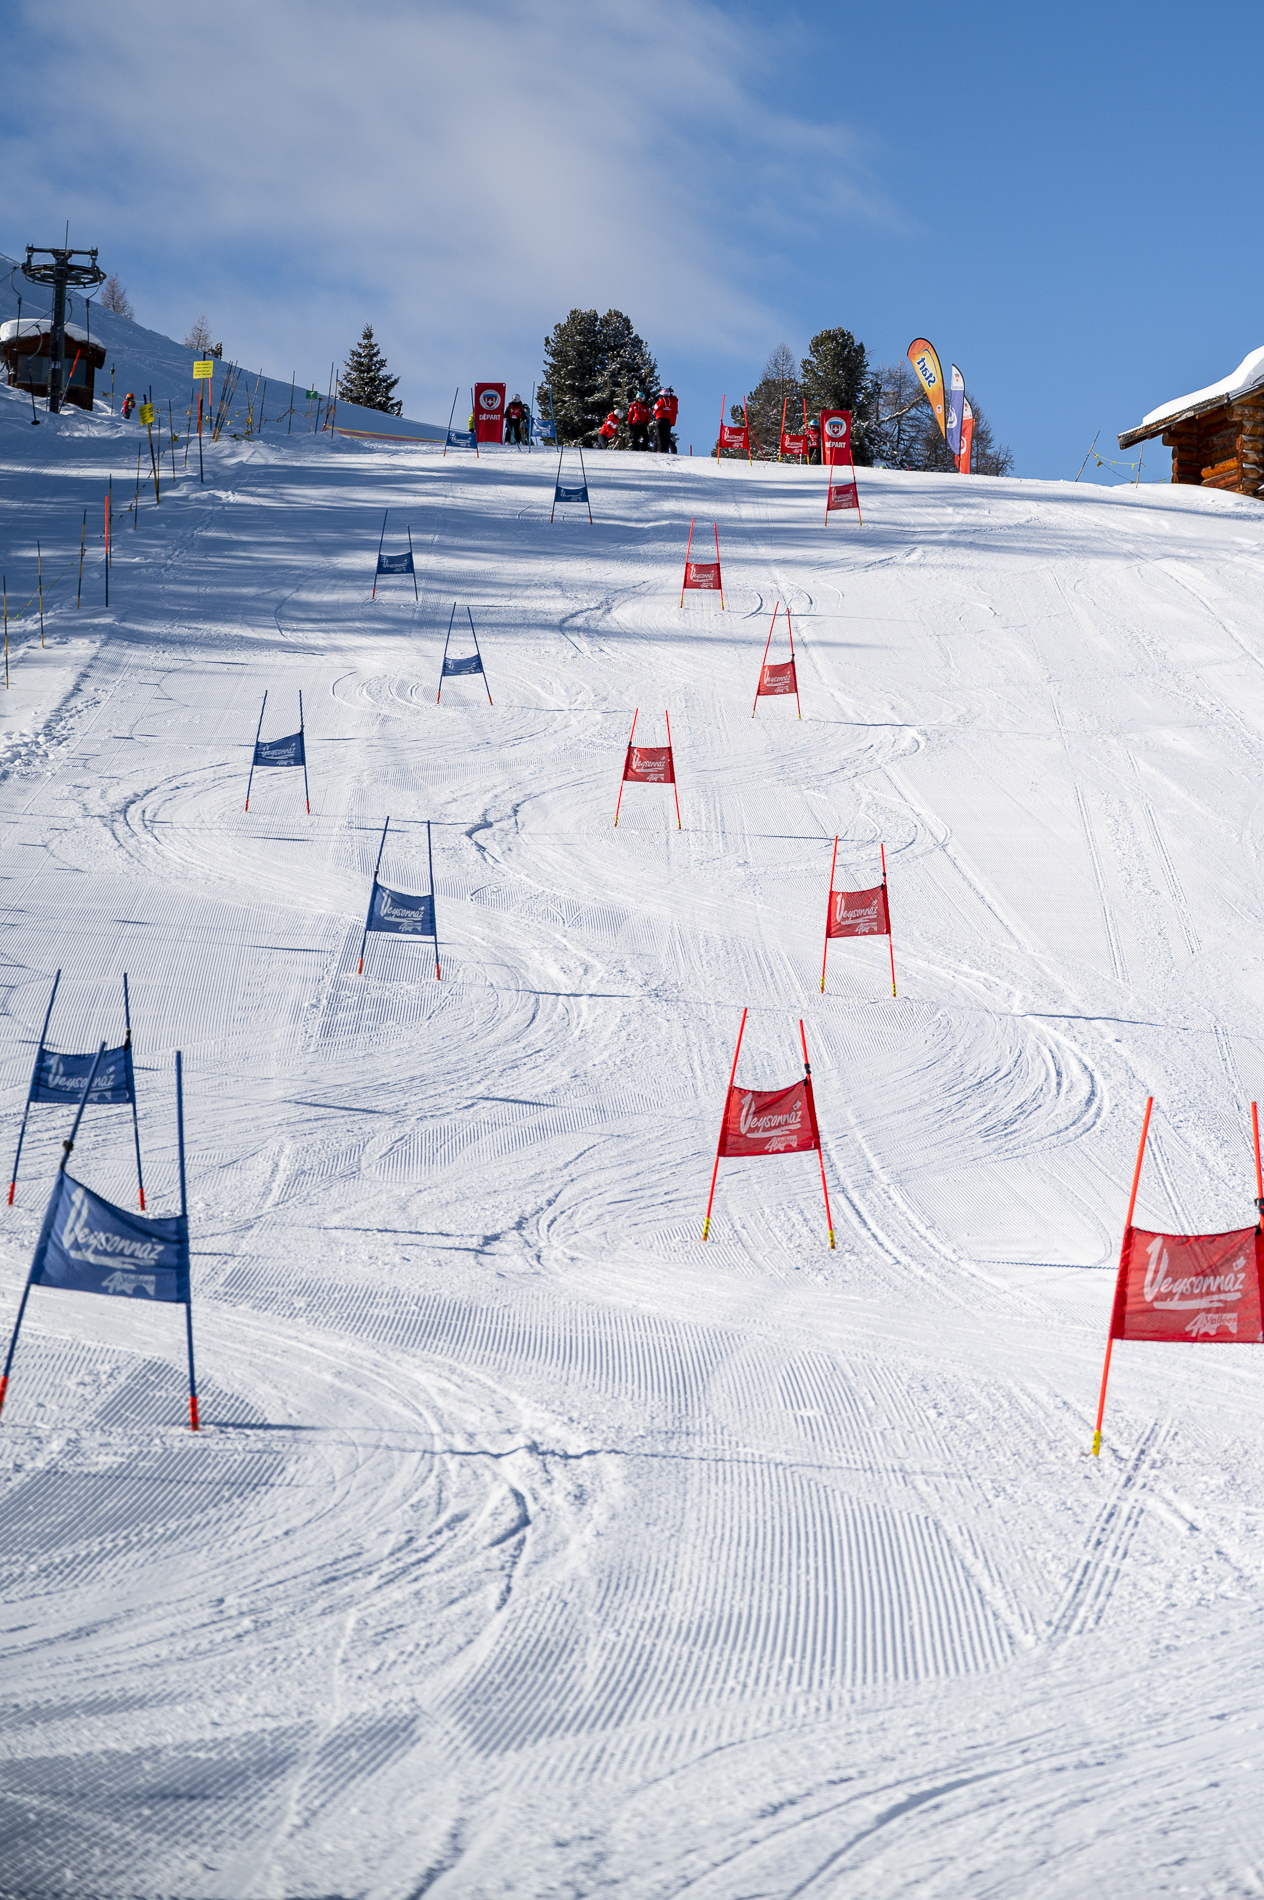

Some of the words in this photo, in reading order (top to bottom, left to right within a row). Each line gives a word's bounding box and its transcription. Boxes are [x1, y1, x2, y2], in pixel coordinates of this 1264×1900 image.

[479, 413, 501, 421] DÉPART
[825, 440, 846, 448] DÉPART
[380, 889, 425, 918] Veysonnaz
[836, 893, 878, 923] Veysonnaz
[48, 1054, 116, 1091] Veysonaz
[739, 1092, 803, 1135] Veysonnaz
[764, 1137, 778, 1153] 4
[62, 1187, 165, 1260] Veysonnaz
[101, 1271, 123, 1294] 4
[1143, 1235, 1247, 1303] Veysonnaz
[1185, 1312, 1206, 1337] 4
[1205, 1314, 1237, 1326] Vallées
